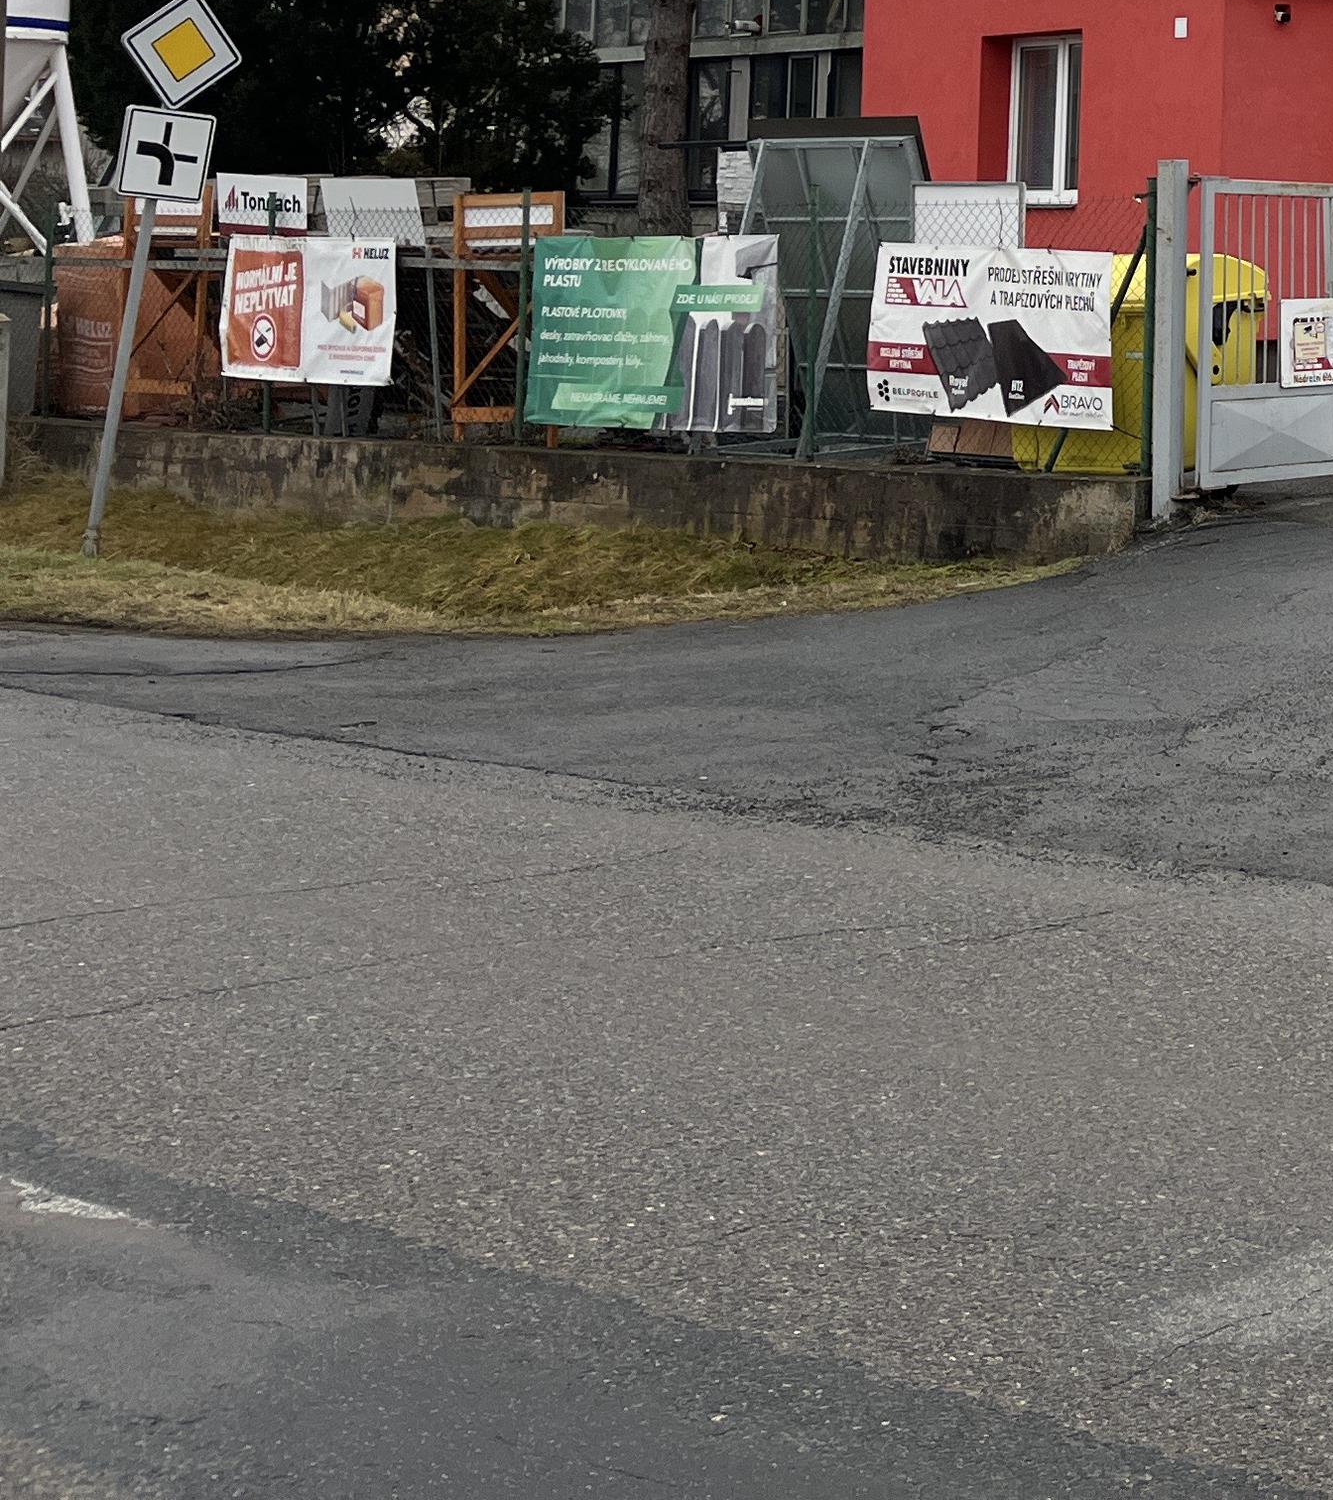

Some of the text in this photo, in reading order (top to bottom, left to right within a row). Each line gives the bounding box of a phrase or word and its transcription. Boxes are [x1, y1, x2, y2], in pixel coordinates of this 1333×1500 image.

[363, 248, 389, 259] HELUZ
[545, 256, 594, 271] VÝROBKY
[602, 257, 691, 271] RECYKLOVANÉHO
[889, 256, 970, 276] STAVEBNINY
[236, 261, 297, 290] NORMÁLNÍ JE
[543, 274, 582, 287] PLASTU
[988, 266, 1020, 283] PRODEJ
[234, 284, 296, 315] NEPLÝTVAT
[676, 294, 696, 304] ZDE
[697, 294, 703, 304] U
[912, 278, 967, 308] VALA
[990, 288, 1095, 312] A TRAPÉZOVÝCH PLECHŮ
[541, 305, 581, 317] PLASTOVÉ
[949, 375, 968, 389] Royal
[892, 387, 938, 398] BELPROFILE
[1061, 395, 1103, 410] BRAVO
